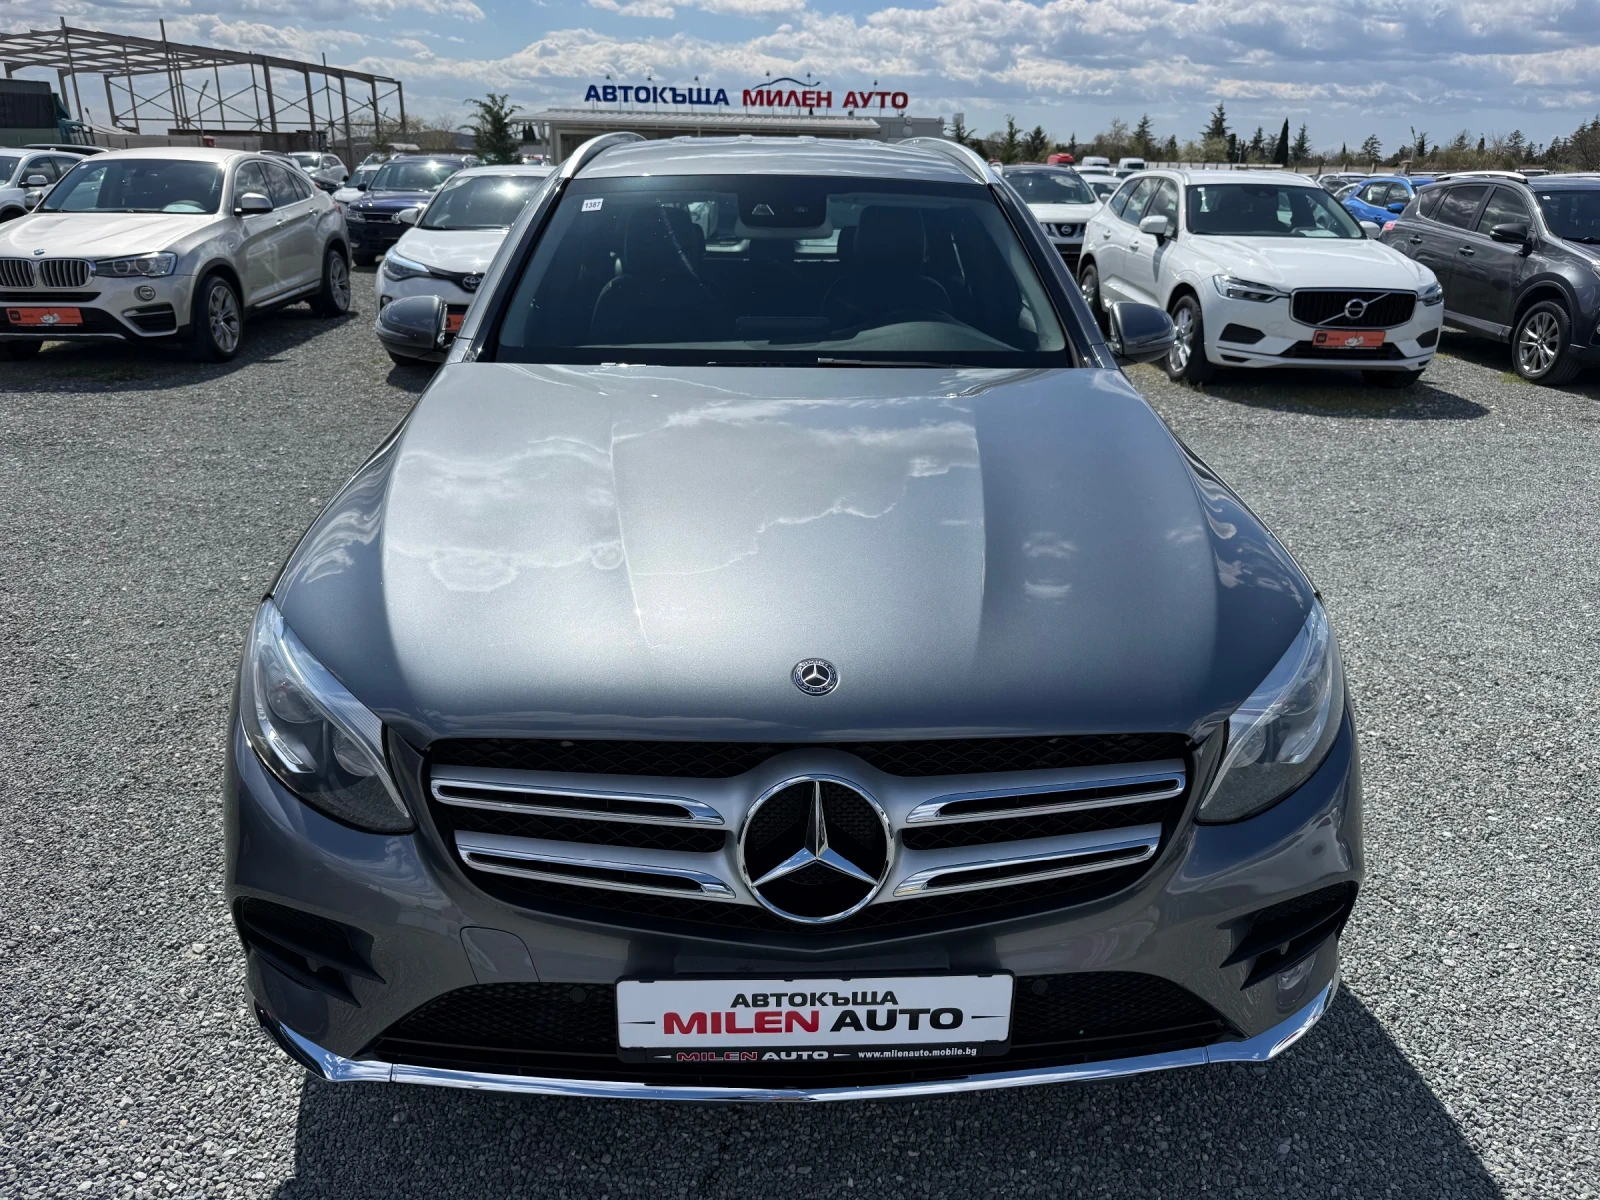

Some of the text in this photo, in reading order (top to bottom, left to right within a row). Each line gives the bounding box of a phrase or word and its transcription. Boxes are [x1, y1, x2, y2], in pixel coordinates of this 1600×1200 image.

[584, 84, 909, 109] АВТОКЪЩА МИЛЕН АУТО
[730, 990, 899, 1008] АВТОКЪЩА
[663, 1007, 964, 1035] MILEN AUTO
[676, 1046, 978, 1062] MILEN AUTO www.milenauto.mobile.bg
